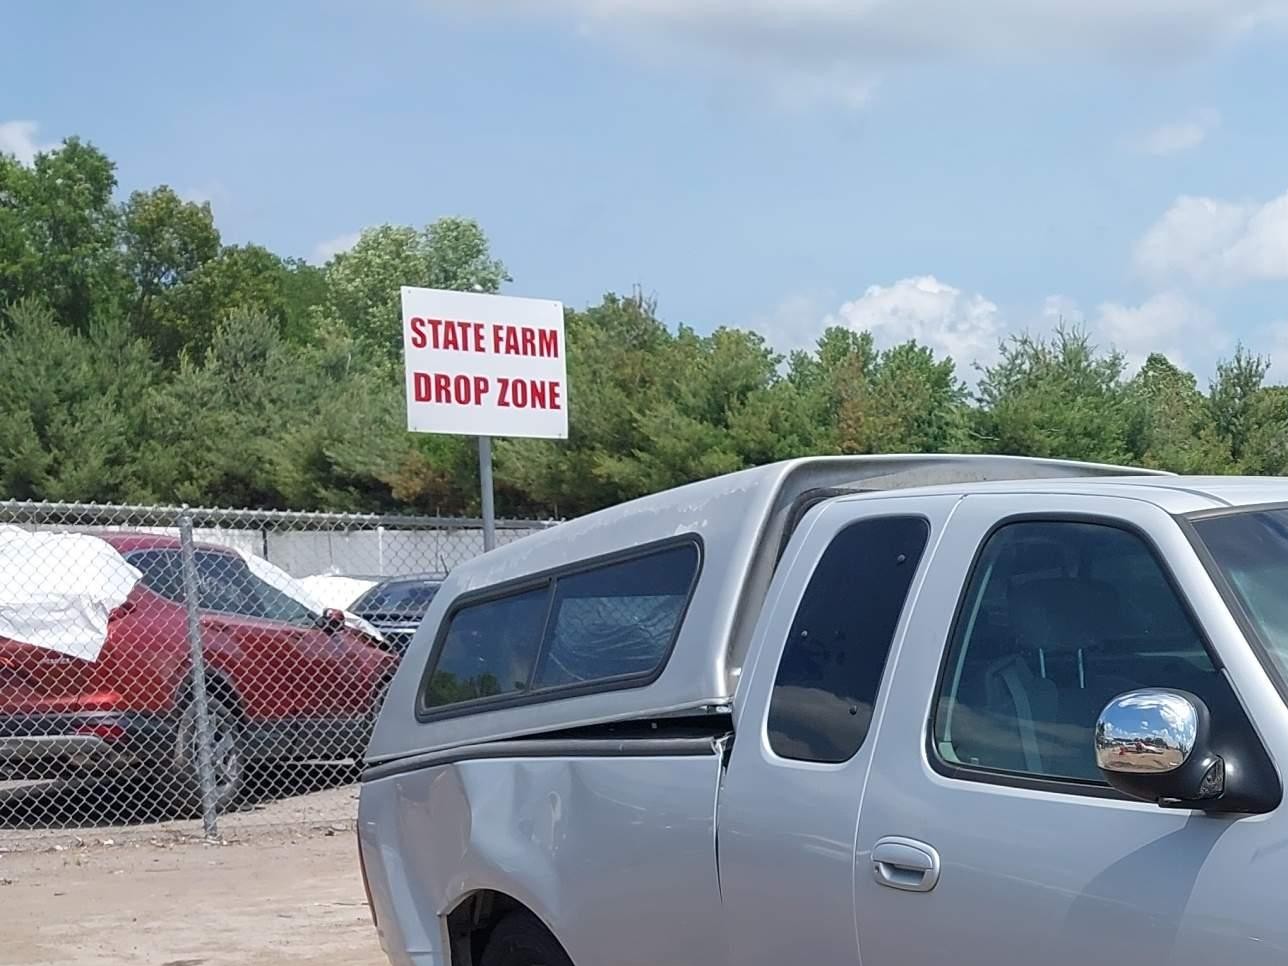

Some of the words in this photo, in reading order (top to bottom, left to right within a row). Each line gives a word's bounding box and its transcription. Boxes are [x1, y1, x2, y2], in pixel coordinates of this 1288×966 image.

[411, 317, 486, 353] STATE
[492, 324, 559, 358] FARM
[413, 372, 489, 405] DROP
[497, 378, 561, 410] ZONE
